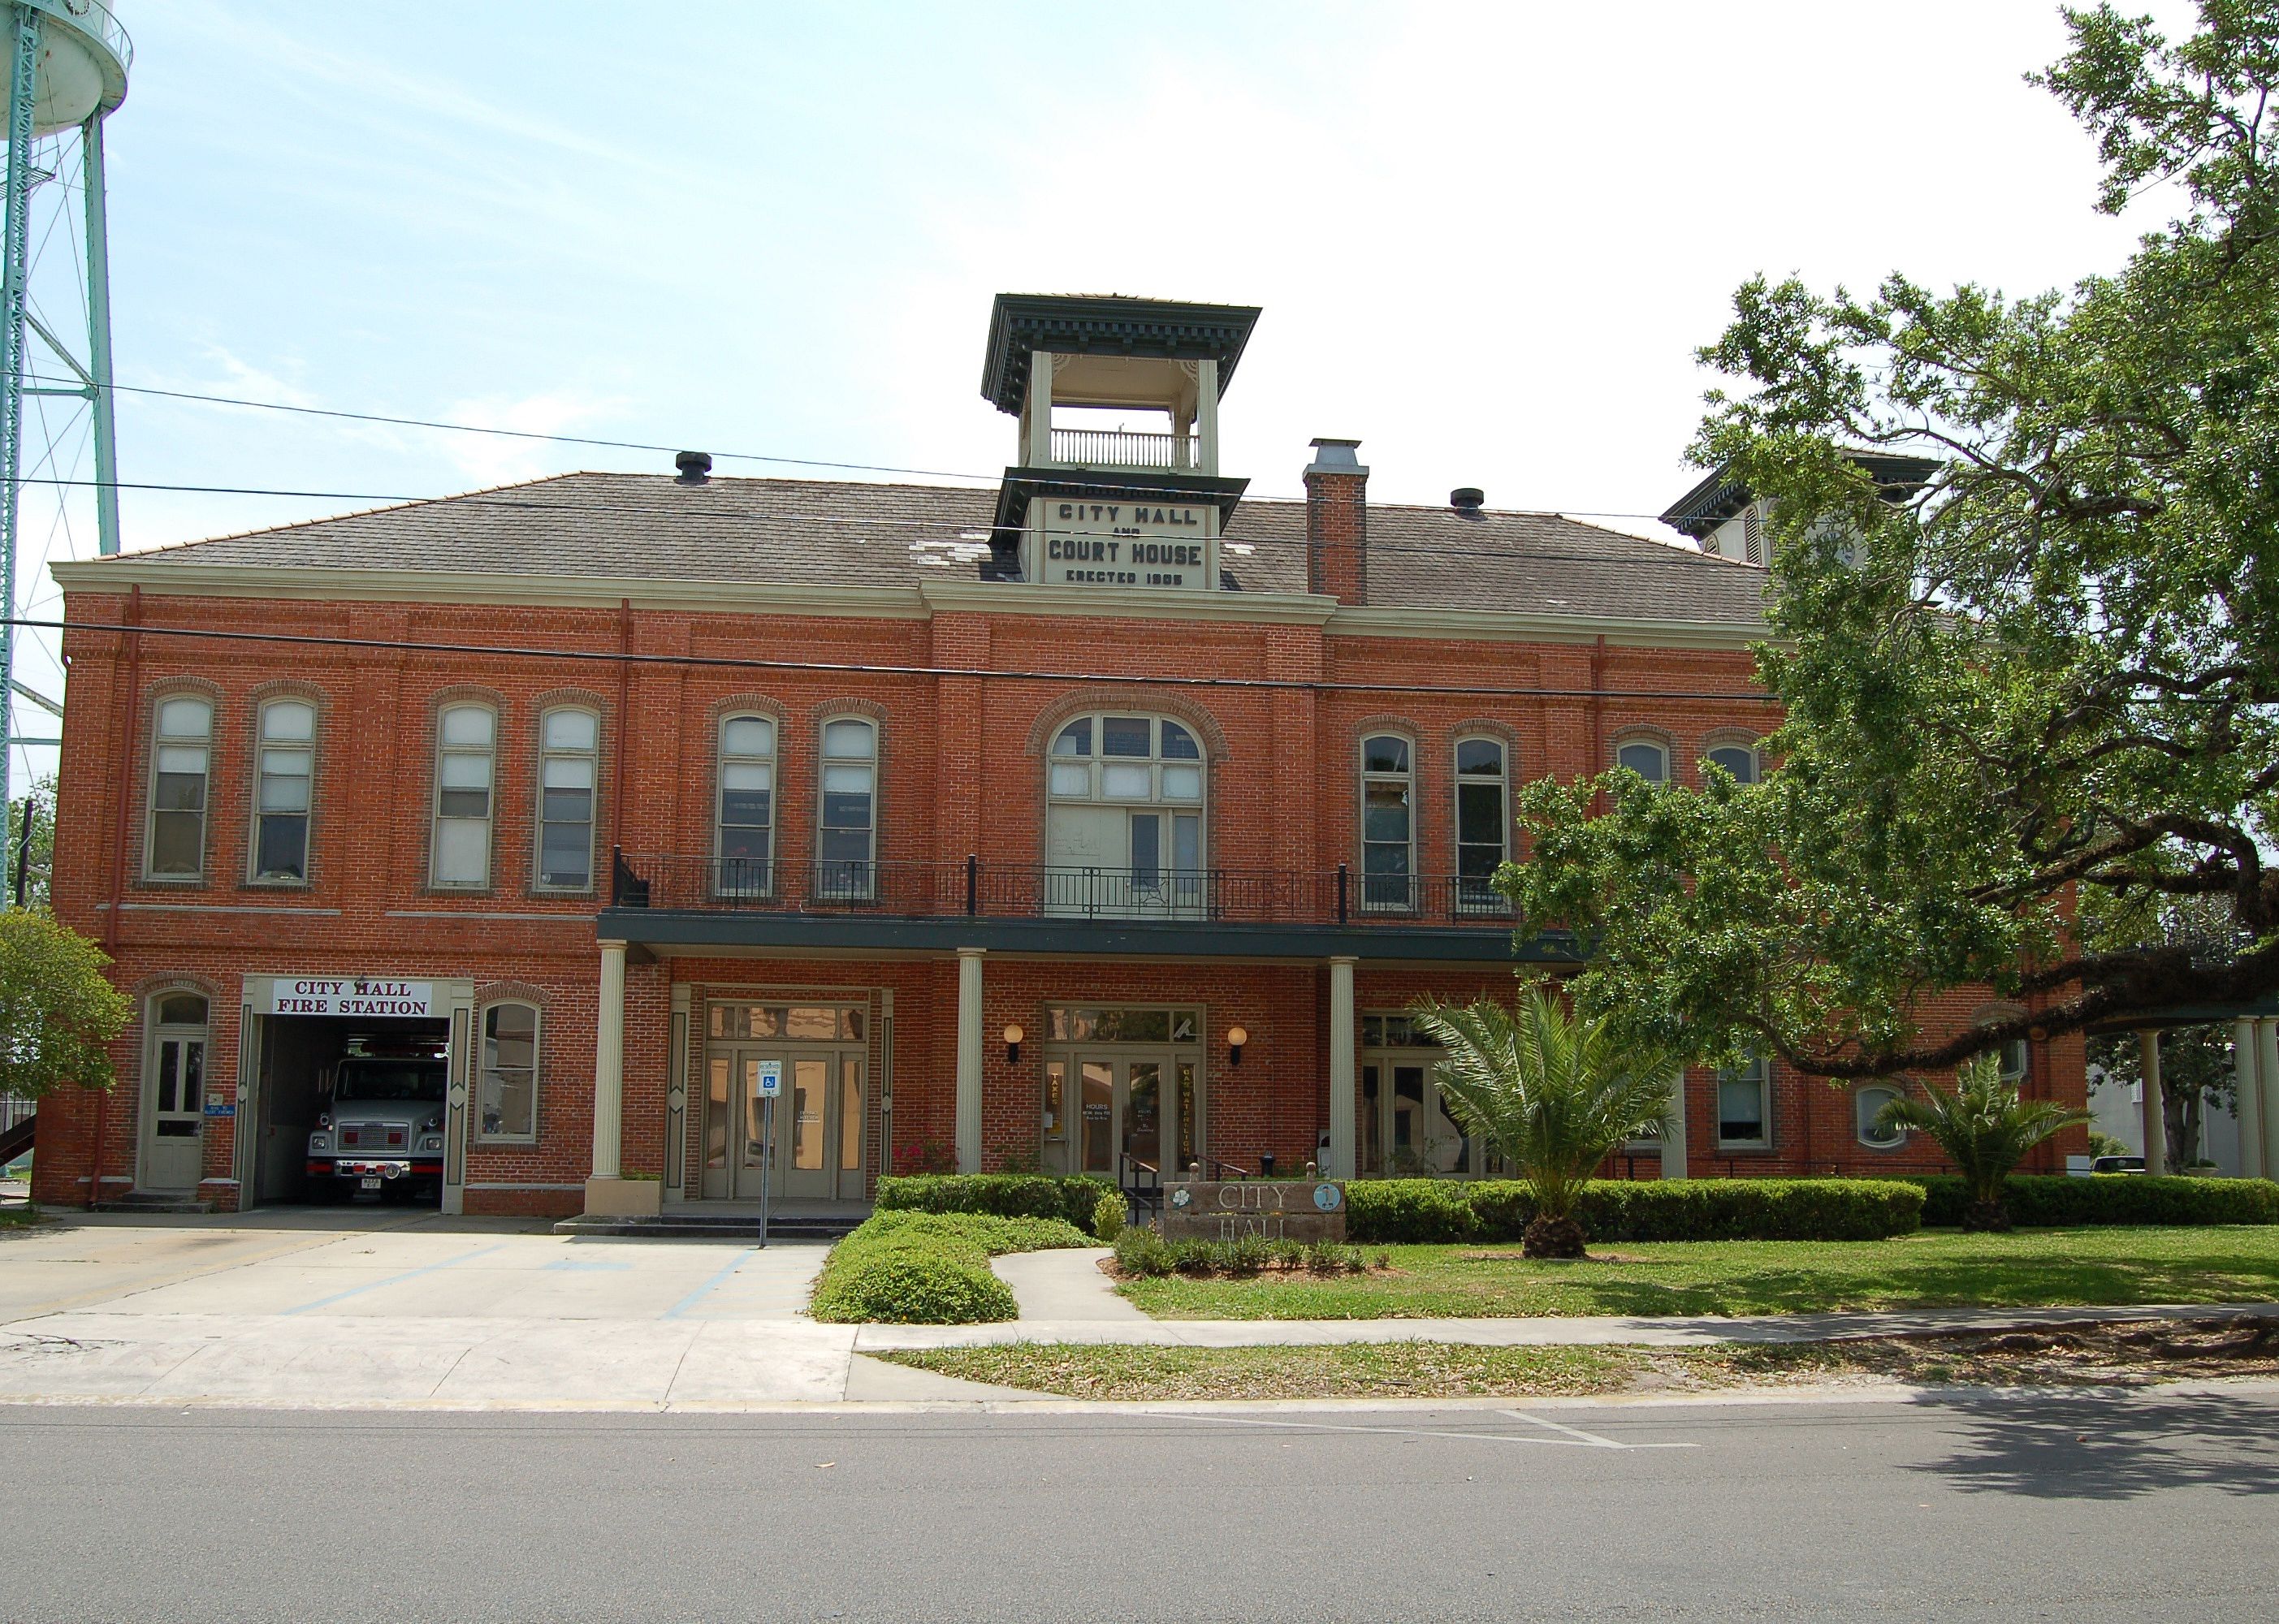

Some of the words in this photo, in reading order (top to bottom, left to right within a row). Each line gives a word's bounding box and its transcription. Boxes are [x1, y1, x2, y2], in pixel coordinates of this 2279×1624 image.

[1059, 504, 1119, 521] CITY
[1135, 508, 1197, 525] HALL
[1113, 527, 1140, 538] AND
[1049, 540, 1119, 562] COURT
[1132, 543, 1201, 565] HOUSE
[1066, 569, 1136, 584] ERECTED
[295, 981, 344, 996] CITY
[353, 983, 411, 996] HALL
[277, 999, 327, 1013] FIRE
[339, 1000, 427, 1015] STATION
[1051, 1073, 1059, 1105] TAXES
[1218, 1186, 1290, 1208] CITY
